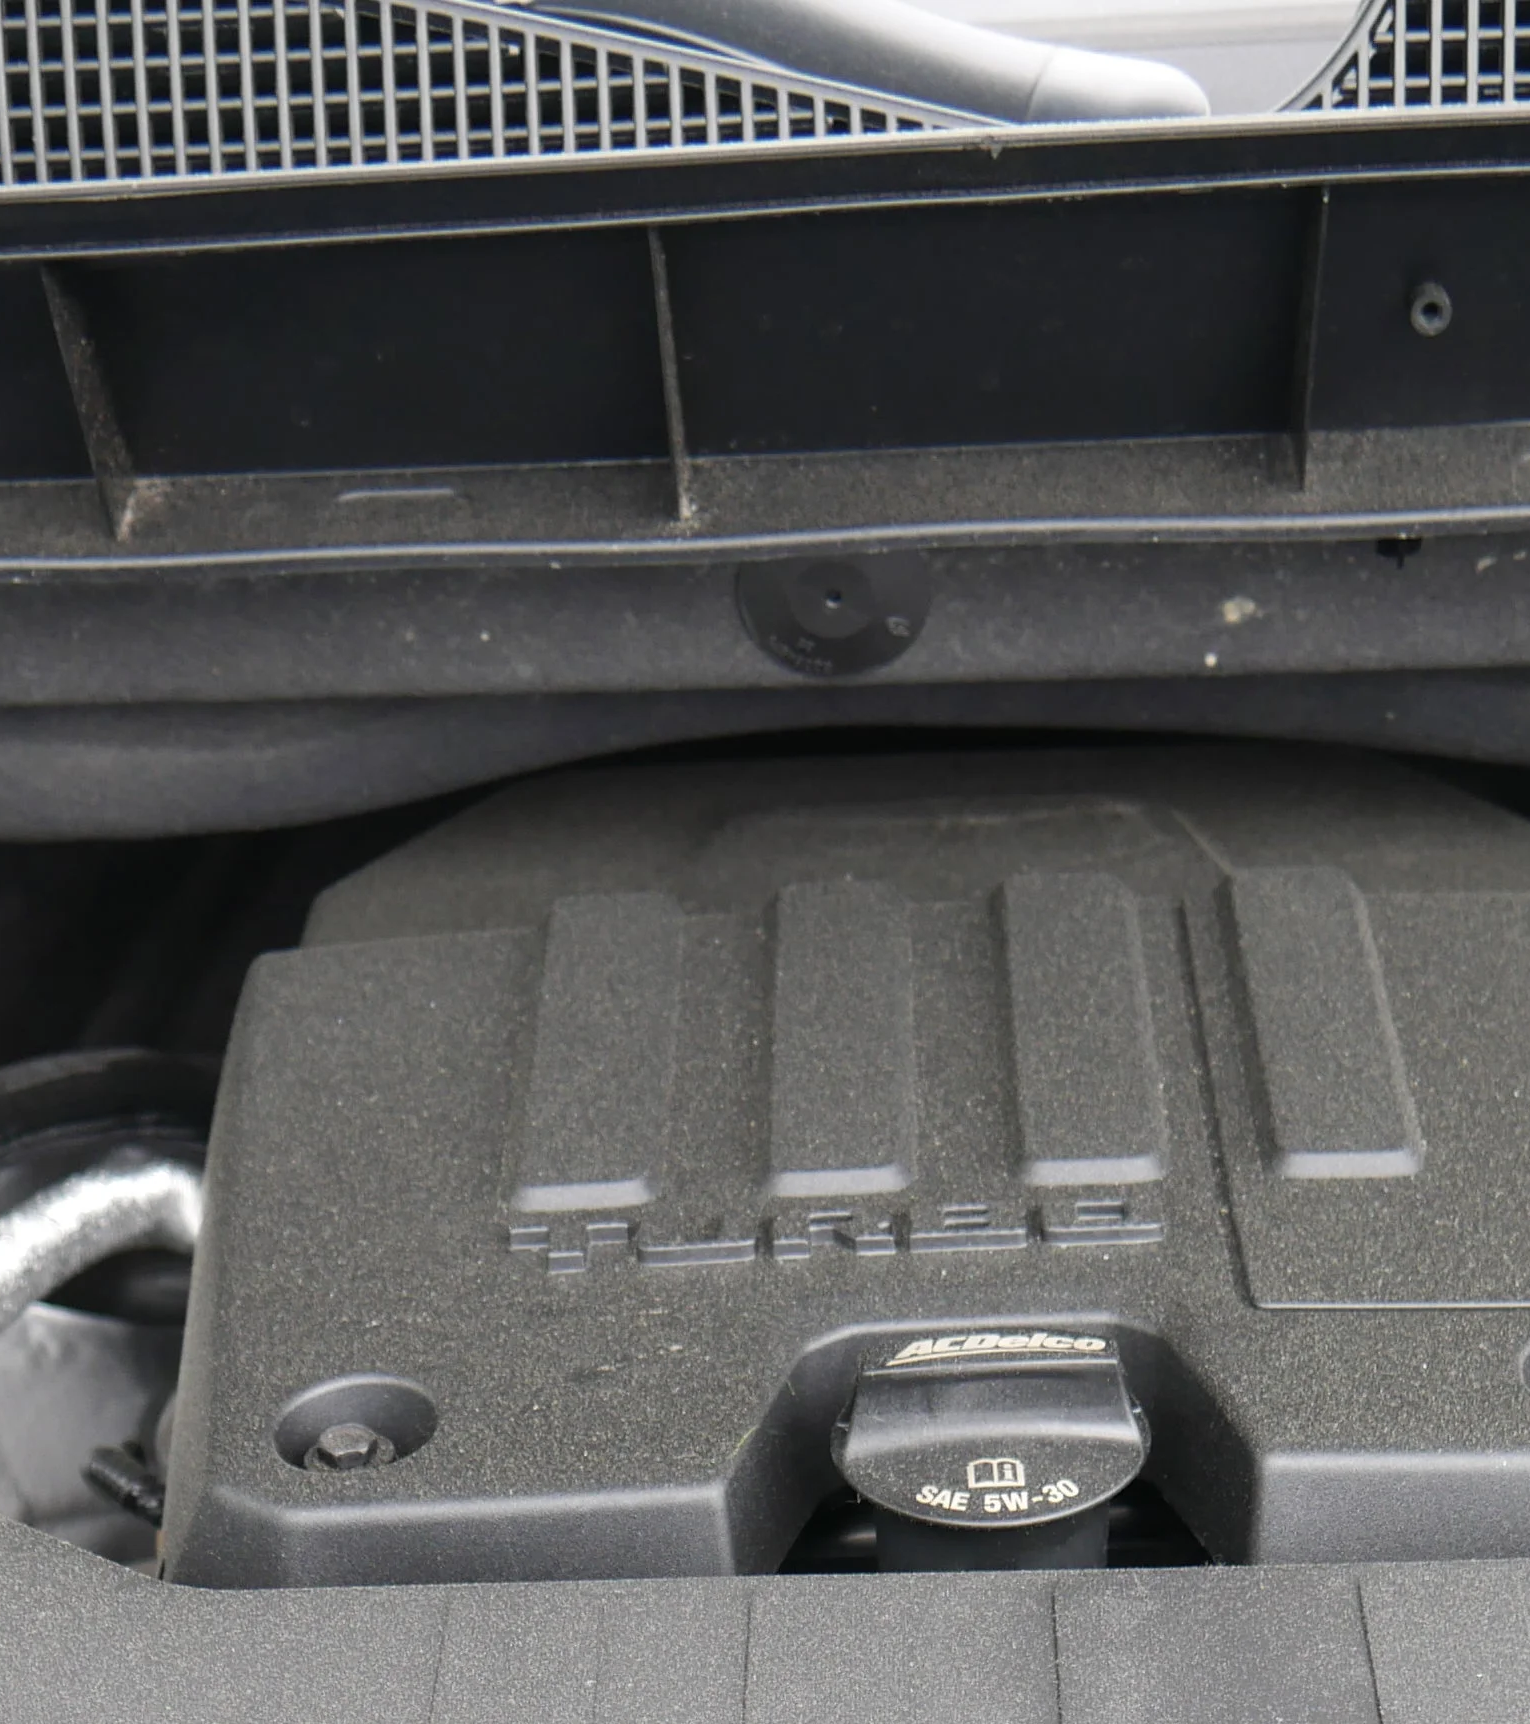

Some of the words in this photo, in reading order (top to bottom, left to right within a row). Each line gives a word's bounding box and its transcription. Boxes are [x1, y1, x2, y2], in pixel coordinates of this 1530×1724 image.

[887, 1332, 1106, 1364] ACDelco
[915, 1485, 970, 1512] SAE
[983, 1479, 1080, 1513] 5W-30
